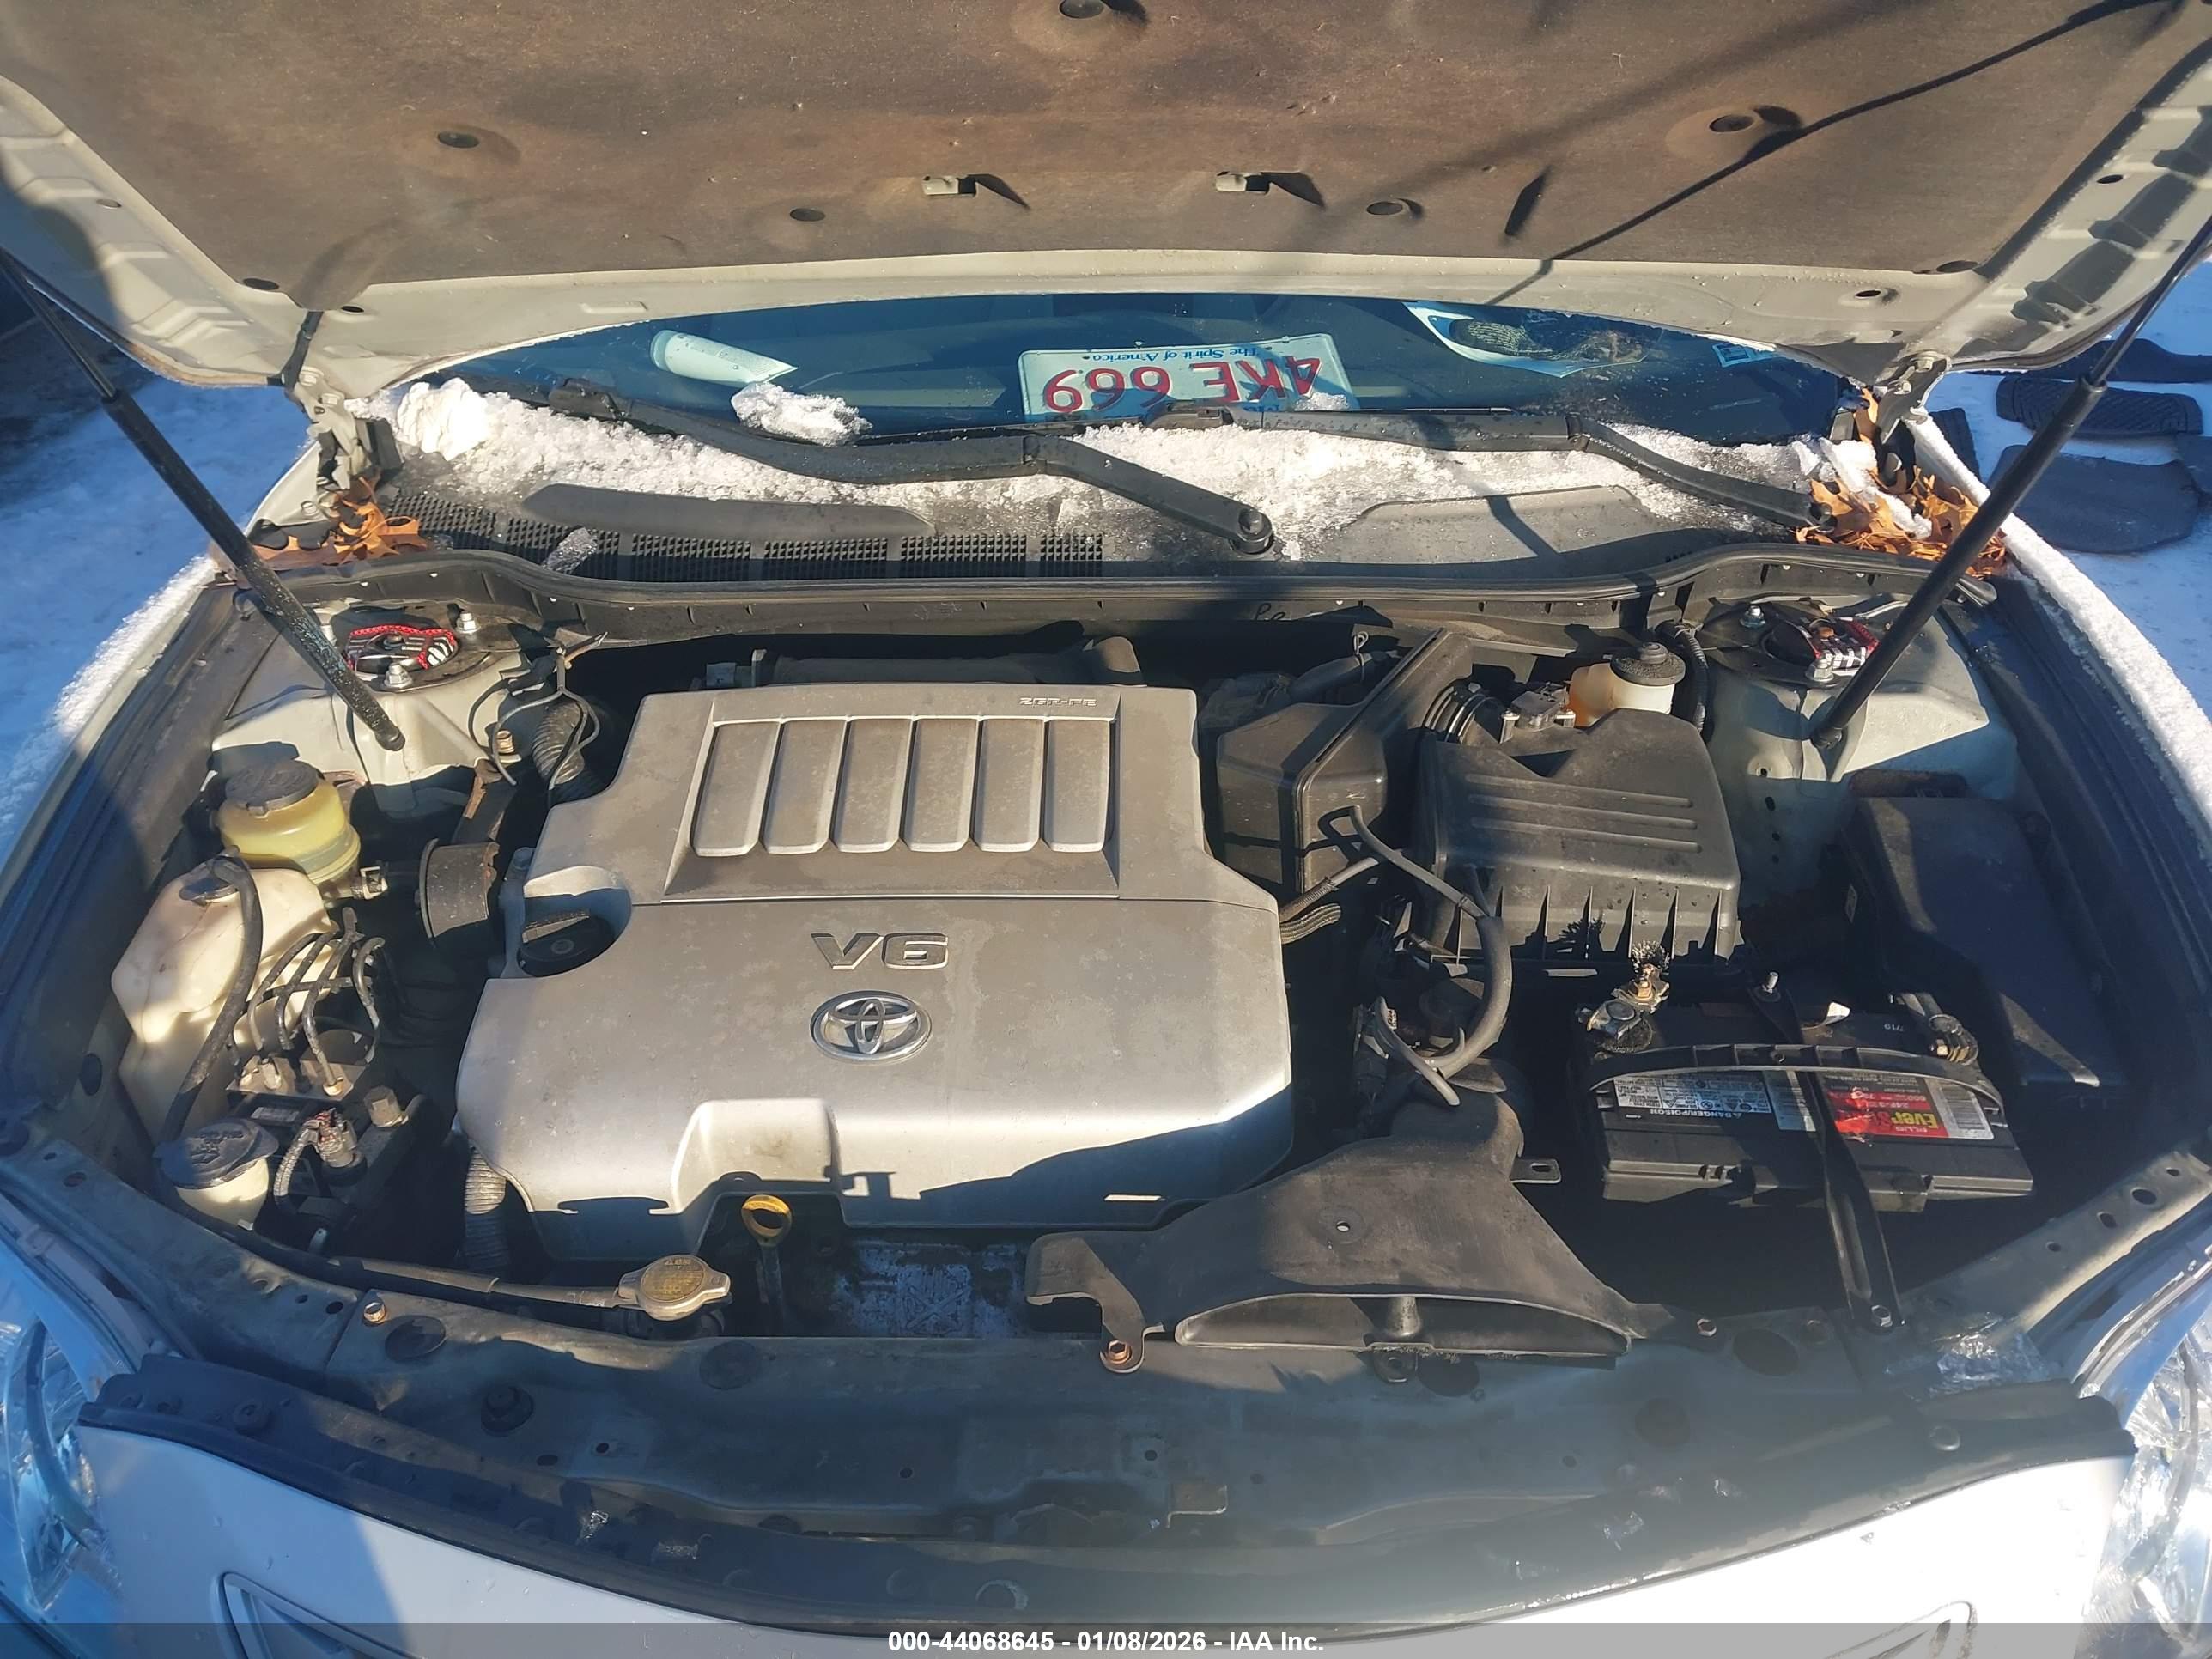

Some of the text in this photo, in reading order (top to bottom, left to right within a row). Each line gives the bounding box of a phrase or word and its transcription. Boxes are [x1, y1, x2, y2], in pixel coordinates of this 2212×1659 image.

[1092, 346, 1260, 363] The Spirit of America
[1042, 356, 1322, 414] 4KE 669
[810, 932, 949, 970] V6
[1650, 1108, 1733, 1119] DANGER/POISON
